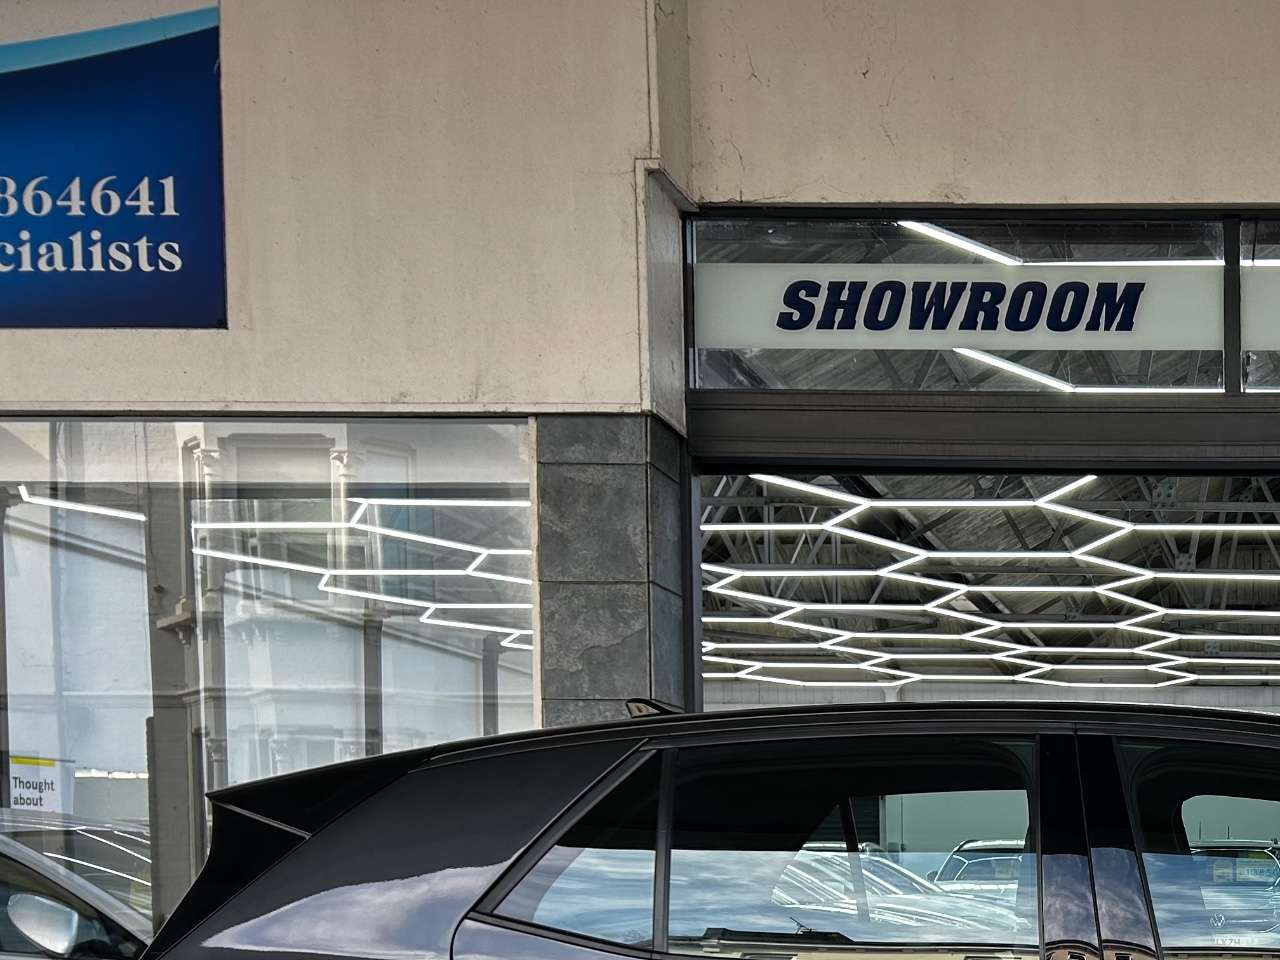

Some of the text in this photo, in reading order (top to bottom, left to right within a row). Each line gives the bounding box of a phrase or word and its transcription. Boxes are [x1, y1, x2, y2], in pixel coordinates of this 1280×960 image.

[0, 175, 180, 217] 864641
[776, 280, 1147, 332] SHOWROOM
[12, 776, 55, 793] Thought
[13, 794, 43, 806] about
